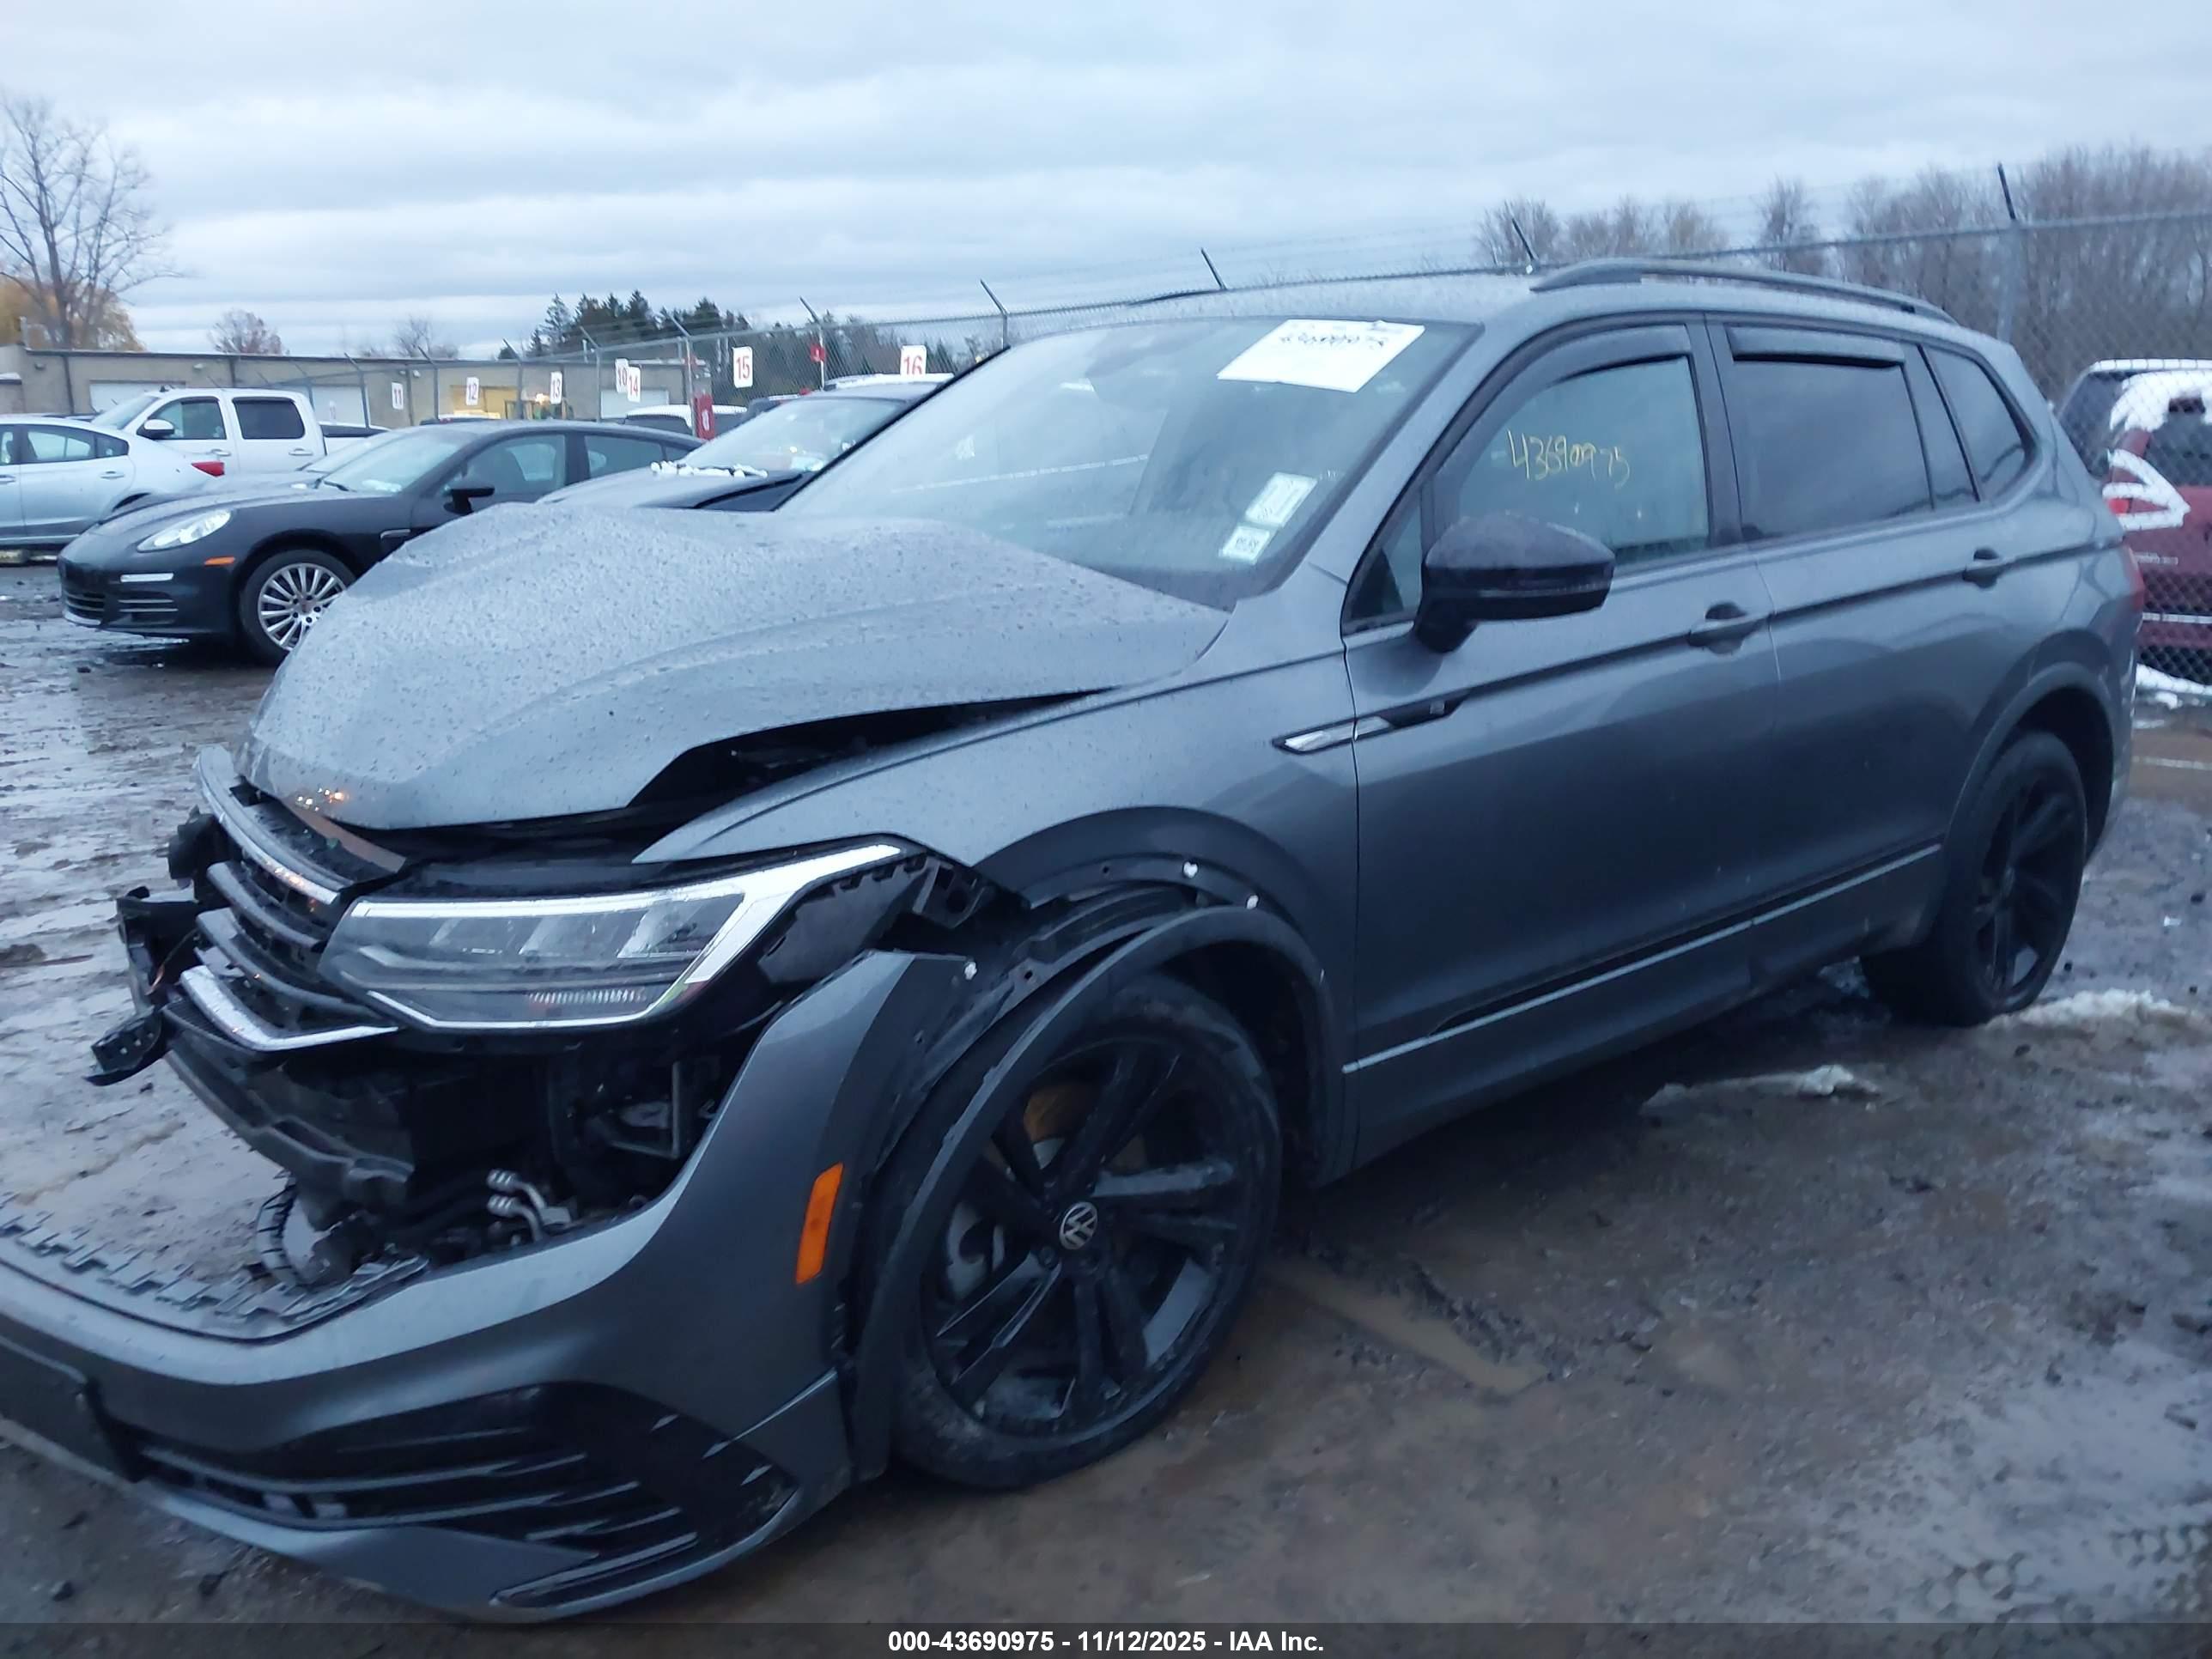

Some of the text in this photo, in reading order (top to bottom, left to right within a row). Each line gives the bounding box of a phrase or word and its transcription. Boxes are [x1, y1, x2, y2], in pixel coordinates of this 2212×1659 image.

[735, 356, 751, 381] 15
[902, 355, 924, 376] 16
[617, 367, 628, 386] 10
[629, 374, 639, 396] 14
[393, 388, 404, 404] 11
[466, 383, 478, 401] 12
[551, 377, 562, 398] 13
